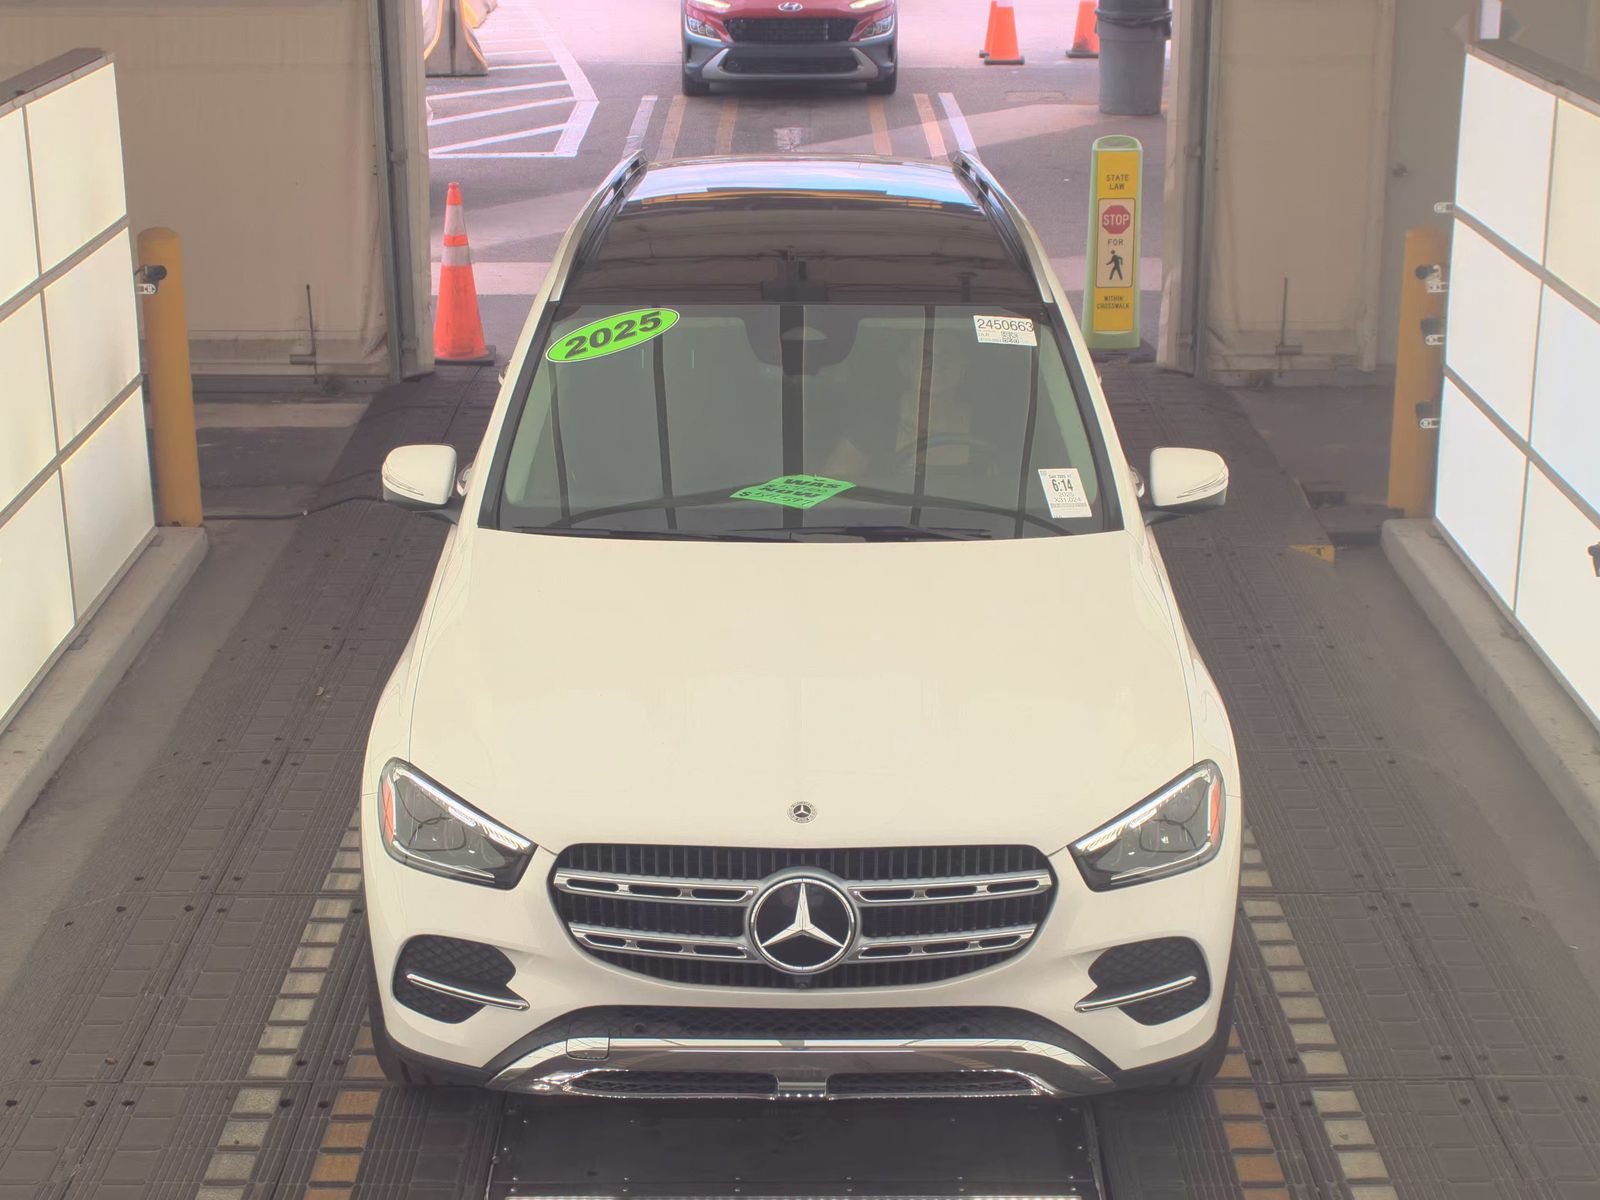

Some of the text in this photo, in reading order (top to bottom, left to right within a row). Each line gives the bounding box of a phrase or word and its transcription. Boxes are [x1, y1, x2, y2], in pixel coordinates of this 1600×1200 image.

[1106, 174, 1129, 182] STATE
[1103, 214, 1130, 226] STOP
[977, 319, 1033, 332] 2450663
[565, 311, 661, 359] 2025
[1052, 479, 1073, 491] 6:14
